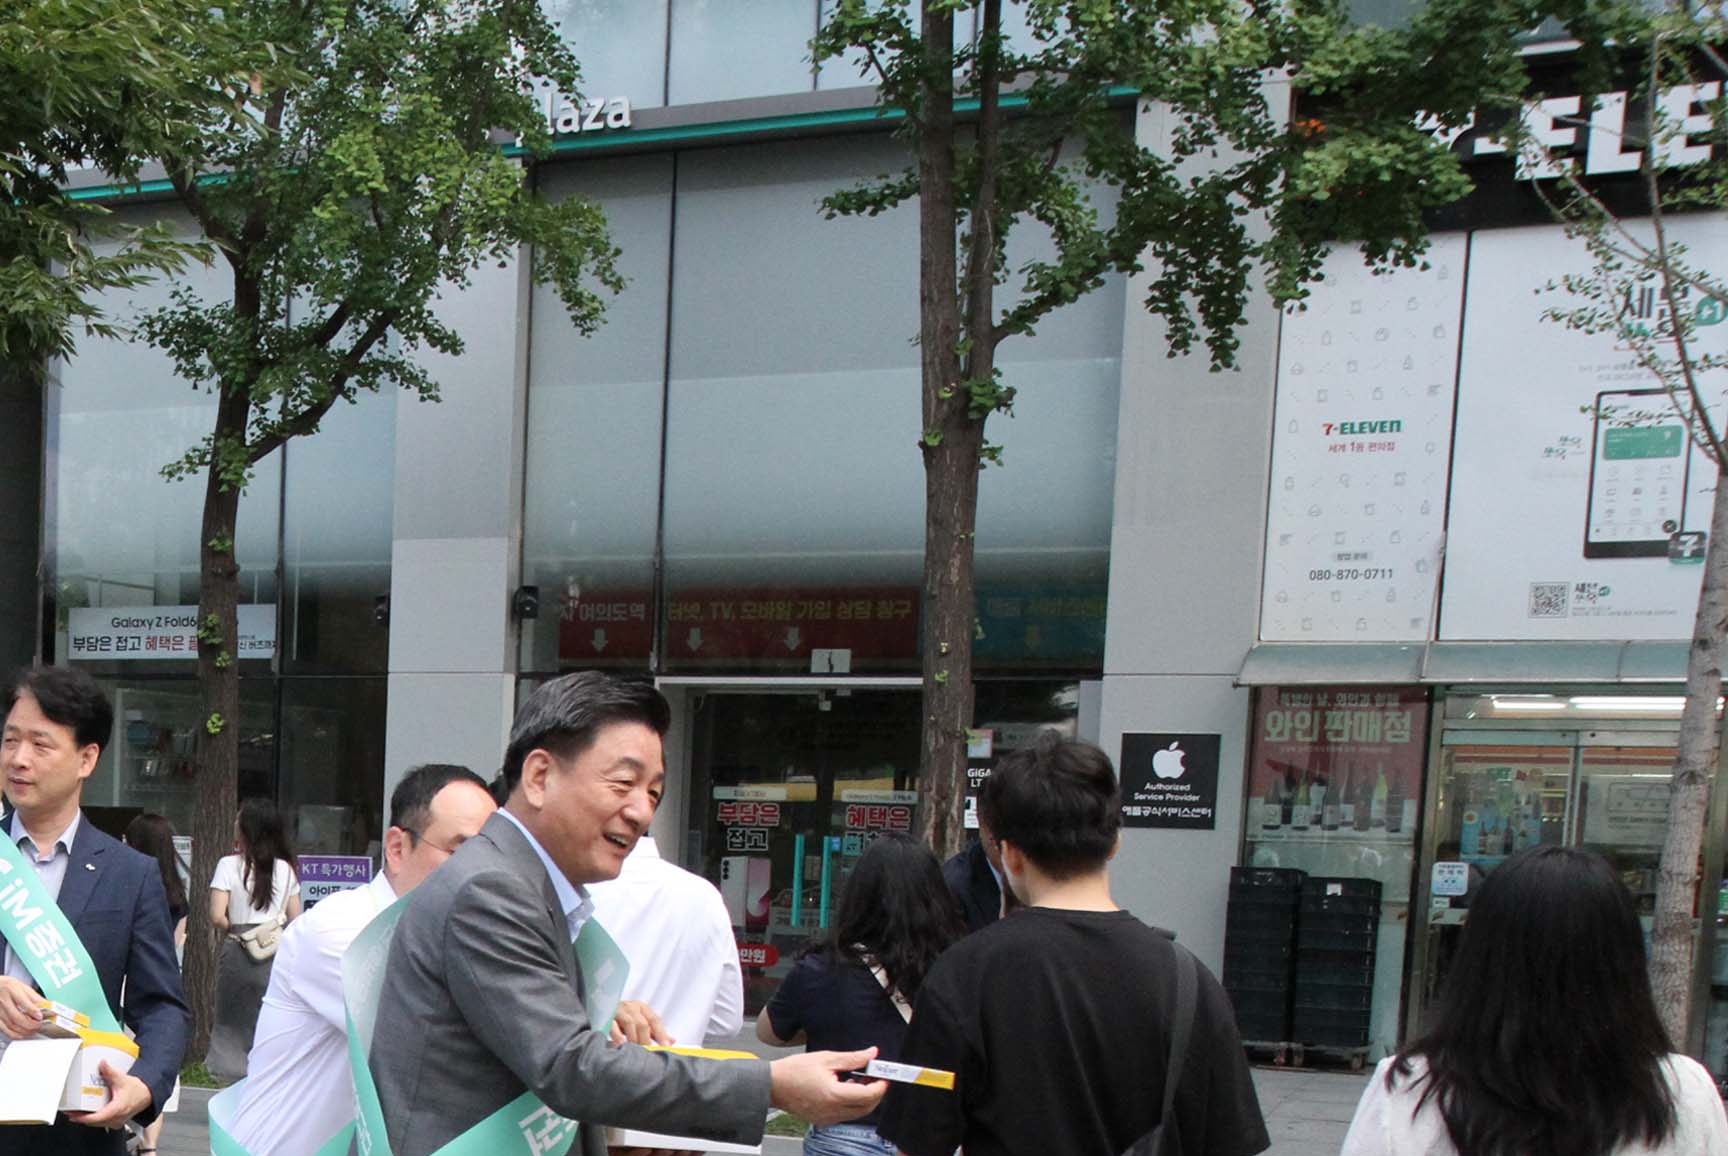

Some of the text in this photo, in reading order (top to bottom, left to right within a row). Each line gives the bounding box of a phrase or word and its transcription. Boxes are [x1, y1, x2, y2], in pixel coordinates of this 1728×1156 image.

[544, 91, 632, 135] laza
[1309, 569, 1393, 581] 080-870-0711
[111, 617, 154, 630] Galaxy
[156, 617, 163, 628] Z
[73, 636, 111, 652] 부담은
[116, 635, 141, 652] 접고
[145, 635, 184, 652] 혜택은
[1264, 710, 1412, 743] 와인 판매점
[970, 778, 983, 788] LT
[1144, 782, 1191, 791] Authorized
[1134, 792, 1201, 801] Service Provider
[717, 802, 780, 827] 부담은
[846, 804, 912, 831] 혜택은
[726, 828, 769, 852] 접고
[302, 863, 366, 878] KT 특가행사
[740, 948, 766, 964] 만원
